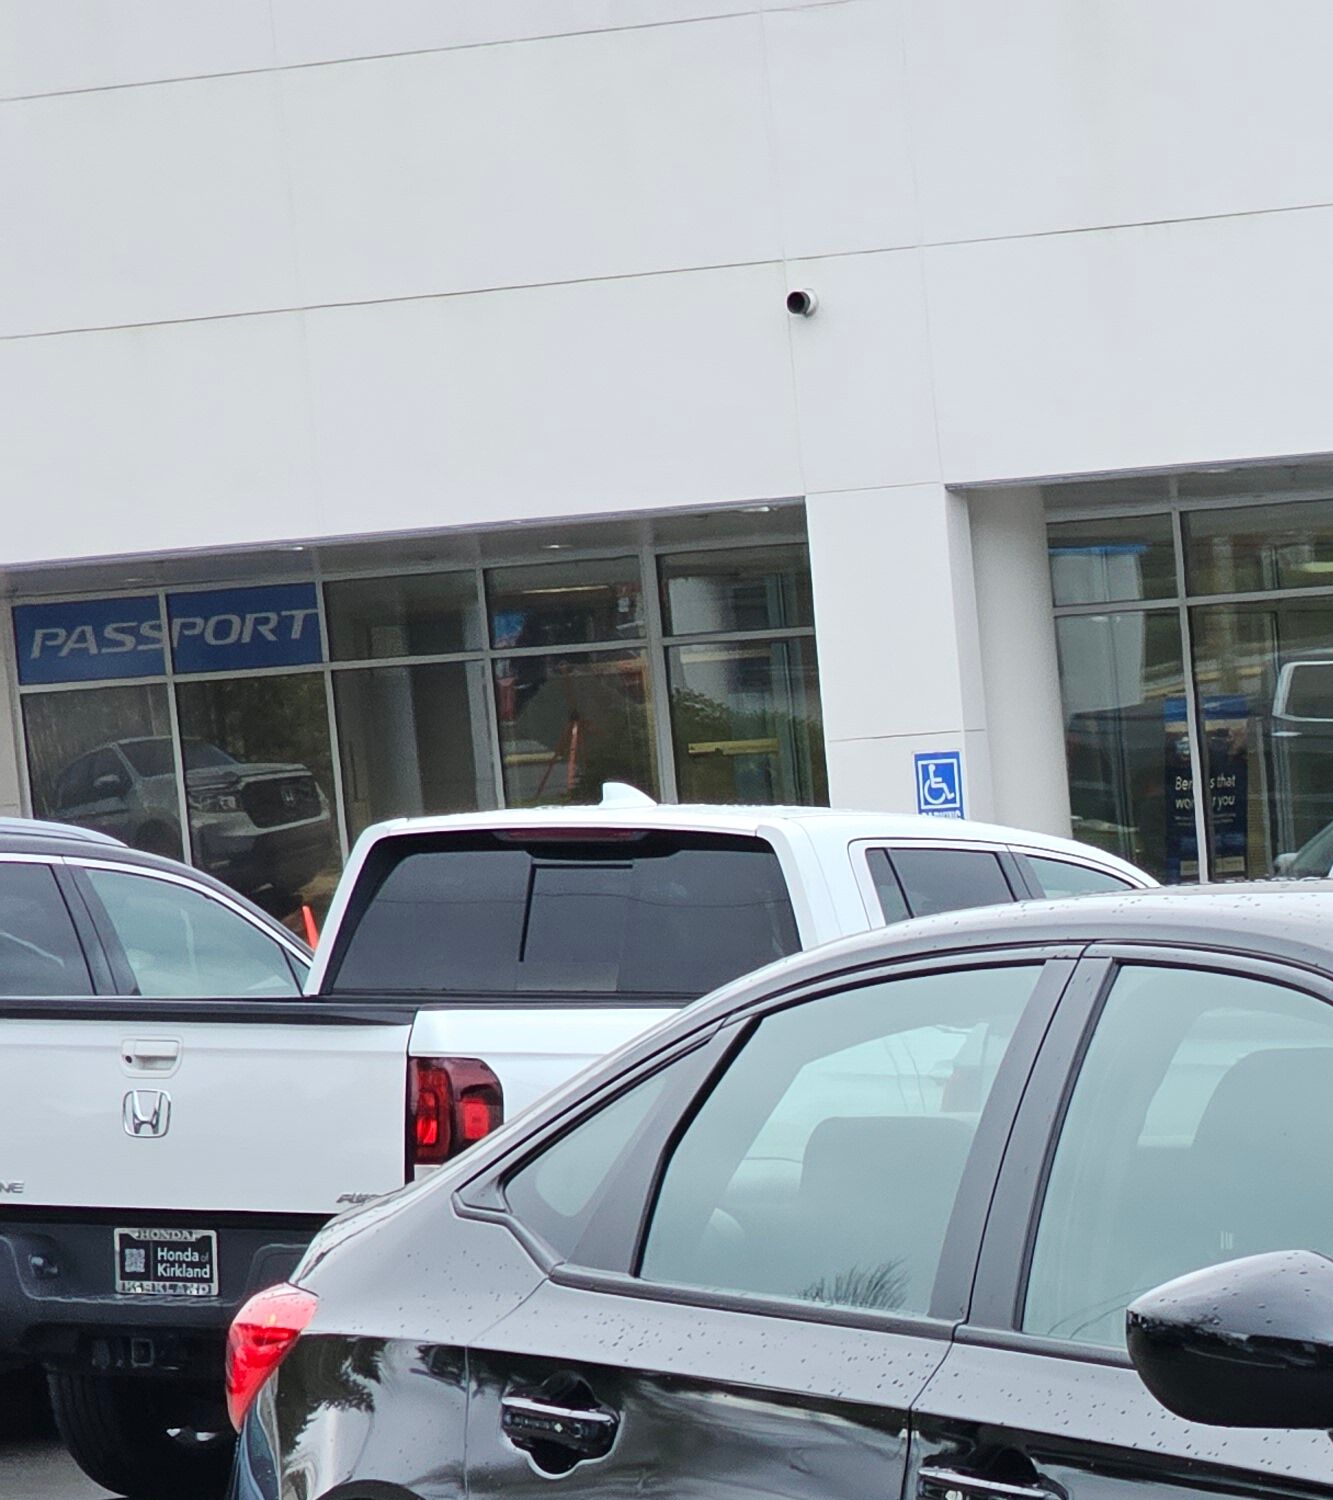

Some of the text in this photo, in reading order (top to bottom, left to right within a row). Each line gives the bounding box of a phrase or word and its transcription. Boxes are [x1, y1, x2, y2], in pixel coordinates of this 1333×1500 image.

[30, 608, 318, 659] PASSPORT
[1217, 774, 1236, 788] that
[1218, 796, 1236, 808] you
[139, 1230, 193, 1241] HONDA
[158, 1247, 209, 1262] Honda of
[158, 1263, 210, 1278] Kirkland
